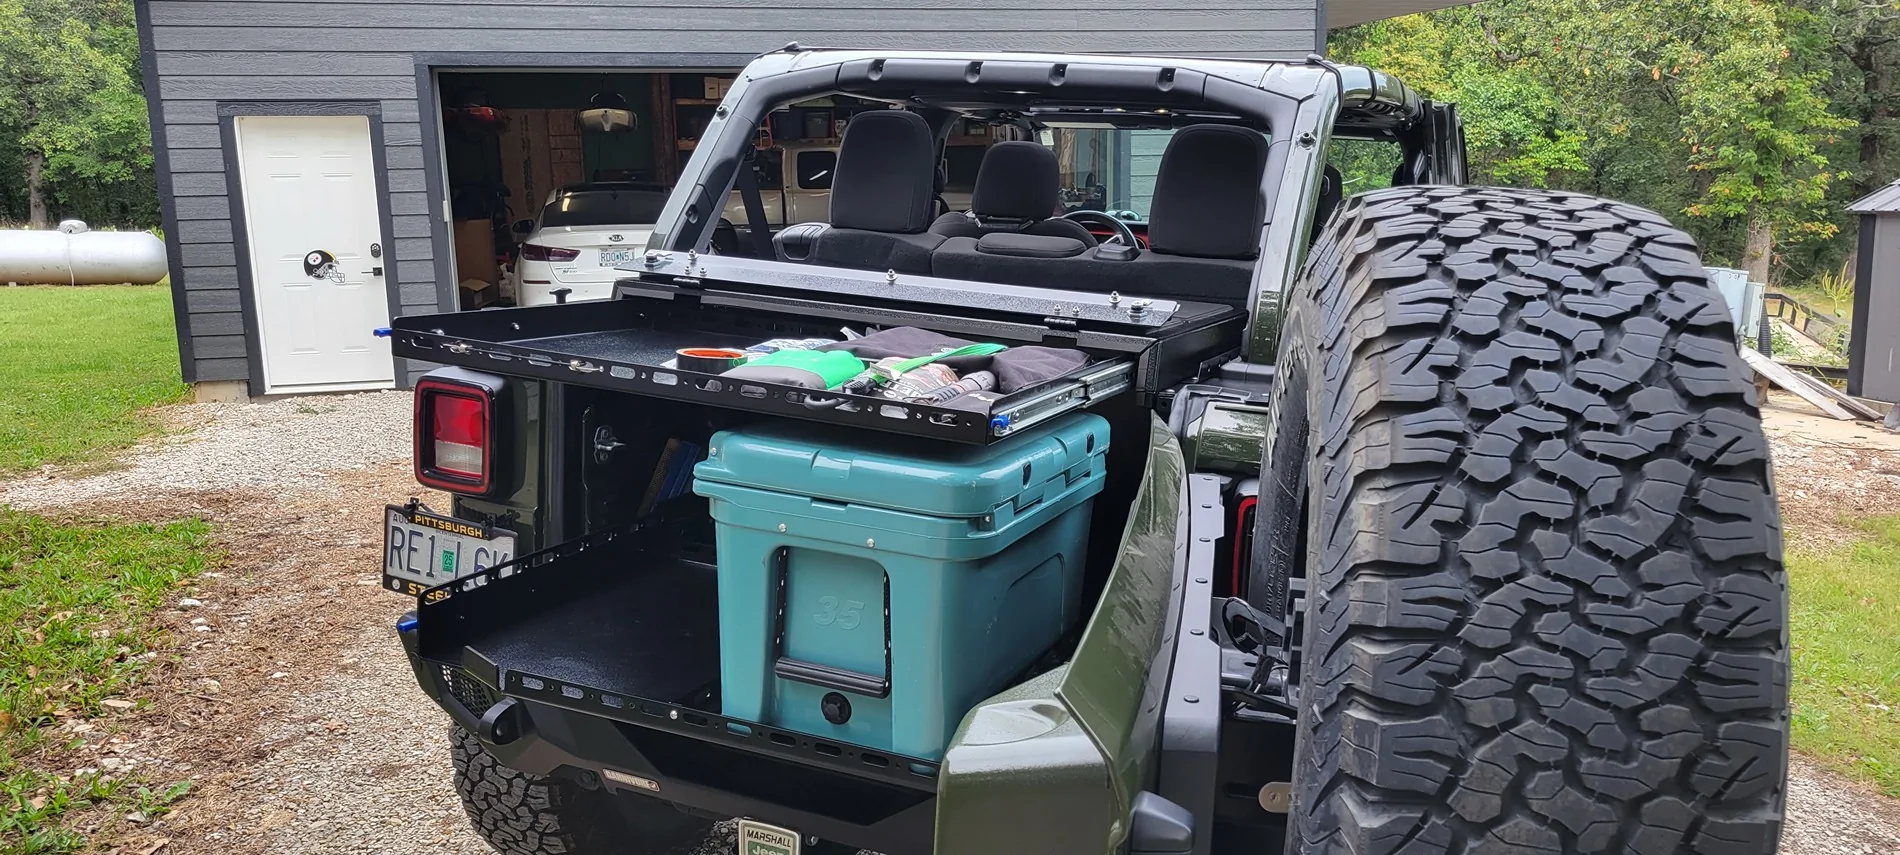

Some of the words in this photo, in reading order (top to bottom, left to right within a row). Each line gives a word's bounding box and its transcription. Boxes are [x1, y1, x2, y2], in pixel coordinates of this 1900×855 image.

[414, 515, 483, 538] PITTSBURGH
[389, 526, 436, 578] RE1
[444, 554, 453, 565] 25
[813, 595, 865, 630] 35
[746, 830, 792, 848] MARSHALL
